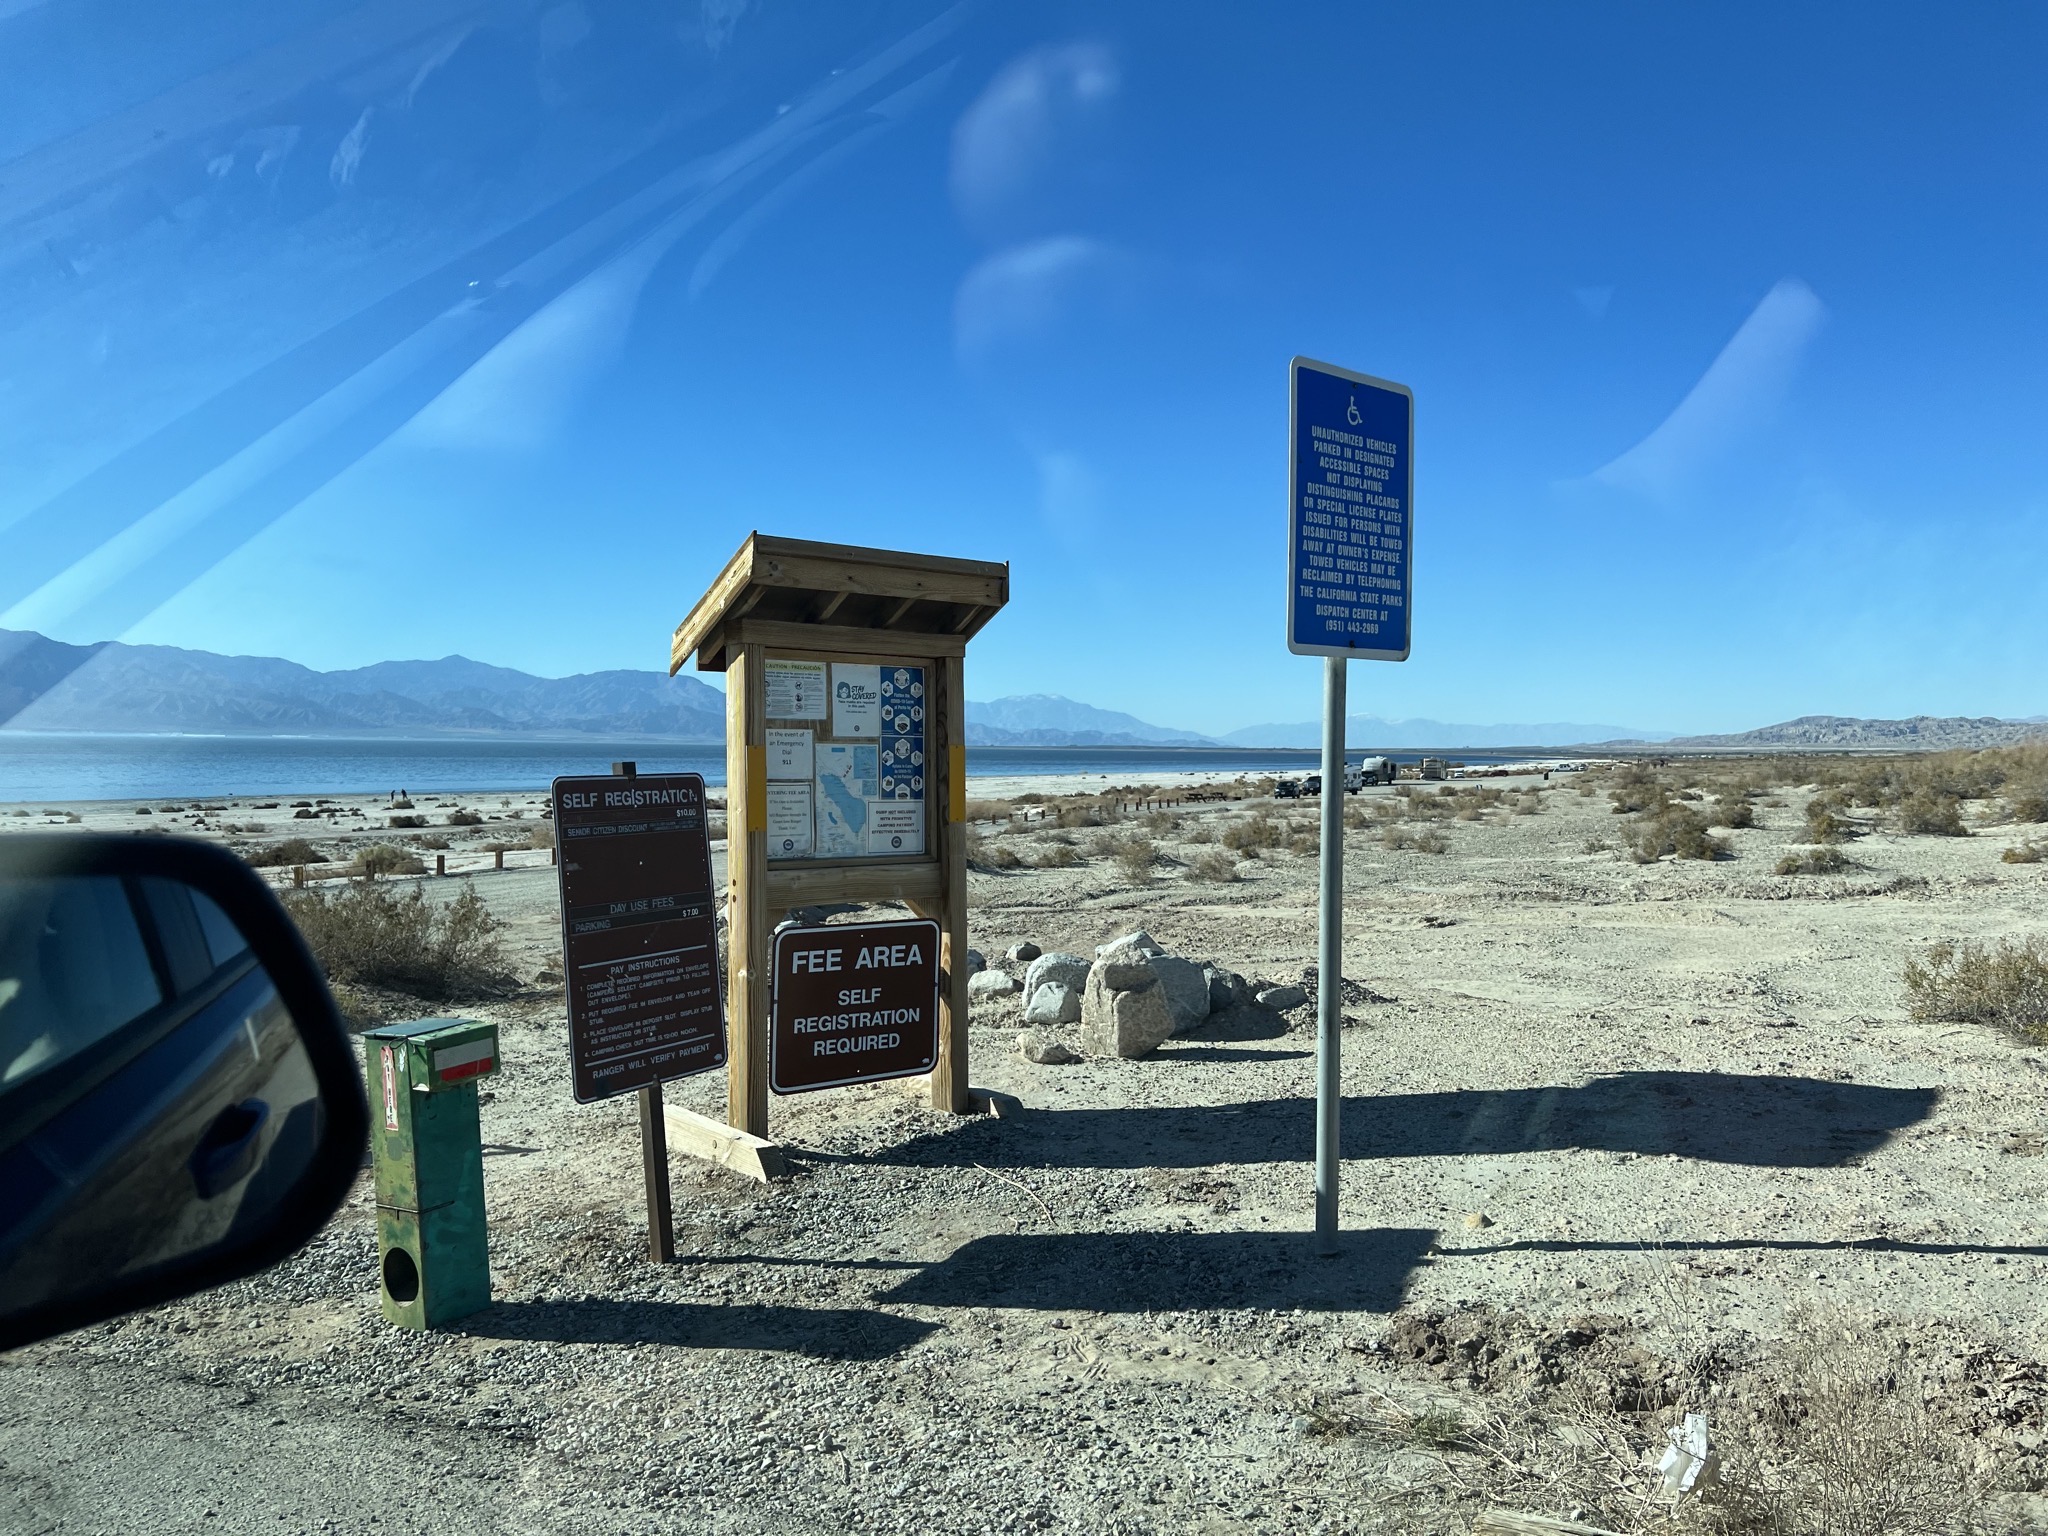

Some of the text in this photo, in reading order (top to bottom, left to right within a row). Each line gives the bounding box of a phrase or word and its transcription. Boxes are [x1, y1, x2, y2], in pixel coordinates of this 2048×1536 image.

[1312, 425, 1396, 454] UNAUTHORIZED VEHICLES
[1314, 441, 1394, 468] PARKED IN DESIGNATED
[1320, 457, 1389, 480] ACCESSIBLE SPACES
[1327, 472, 1382, 492] NOT DISPLAYING
[1308, 482, 1399, 509] DISTINGUISHING PLACARDS
[1304, 496, 1402, 523] OR SPECIAL LICENSE PLATES
[1306, 511, 1400, 536] ISSUED FOR PERSONS WITH
[1303, 525, 1402, 550] DISABILITIES WILL BE TOWED
[1303, 540, 1401, 563] AWAY AT OWNER'S EXPENSE.
[1310, 555, 1395, 576] TOWED VEHICLES MAY BE
[1303, 568, 1400, 590] RECLAIMED BY TELEPHONING
[1300, 586, 1402, 606] THE CALIFORNIA STATE PARKS
[1316, 604, 1388, 621] DISPATCH CENTER AT
[1326, 620, 1343, 632] (951)
[563, 792, 598, 809] SELF
[677, 809, 696, 817] $10.00
[568, 828, 590, 837] SENIOR
[593, 826, 616, 834] CITIZEN
[618, 824, 647, 833] DISCOUNT
[610, 897, 674, 913] DAY USE FEES
[575, 920, 611, 932] PARKING
[611, 956, 680, 974] PAY INSTRUCTIONS
[792, 944, 922, 974] FEE AREA
[587, 980, 614, 990] COMPLETE
[617, 976, 640, 984] REQUIRED
[643, 969, 675, 980] INFORMATION
[685, 963, 709, 972] ENVELOPE
[617, 984, 636, 992] SELECT
[639, 980, 664, 988] CAMPSITE
[692, 970, 709, 979] FILLING
[602, 1005, 626, 1015] REQUIRED
[648, 995, 672, 1006] ENVELOPE
[838, 988, 881, 1006] SELF
[590, 1028, 606, 1037] PLACE
[608, 1022, 634, 1033] ENVELOPE
[643, 1016, 662, 1026] DEPOSIT
[680, 1009, 699, 1018] DISPLAY
[794, 1008, 920, 1034] REGISTRATION
[601, 1031, 631, 1043] INSTRUCTED
[814, 1033, 900, 1056] REQUIRED
[592, 1046, 614, 1057] CAMPING
[616, 1042, 632, 1051] CHECK
[593, 1043, 710, 1079] RANGER WILL VERIFY PAYMENT
